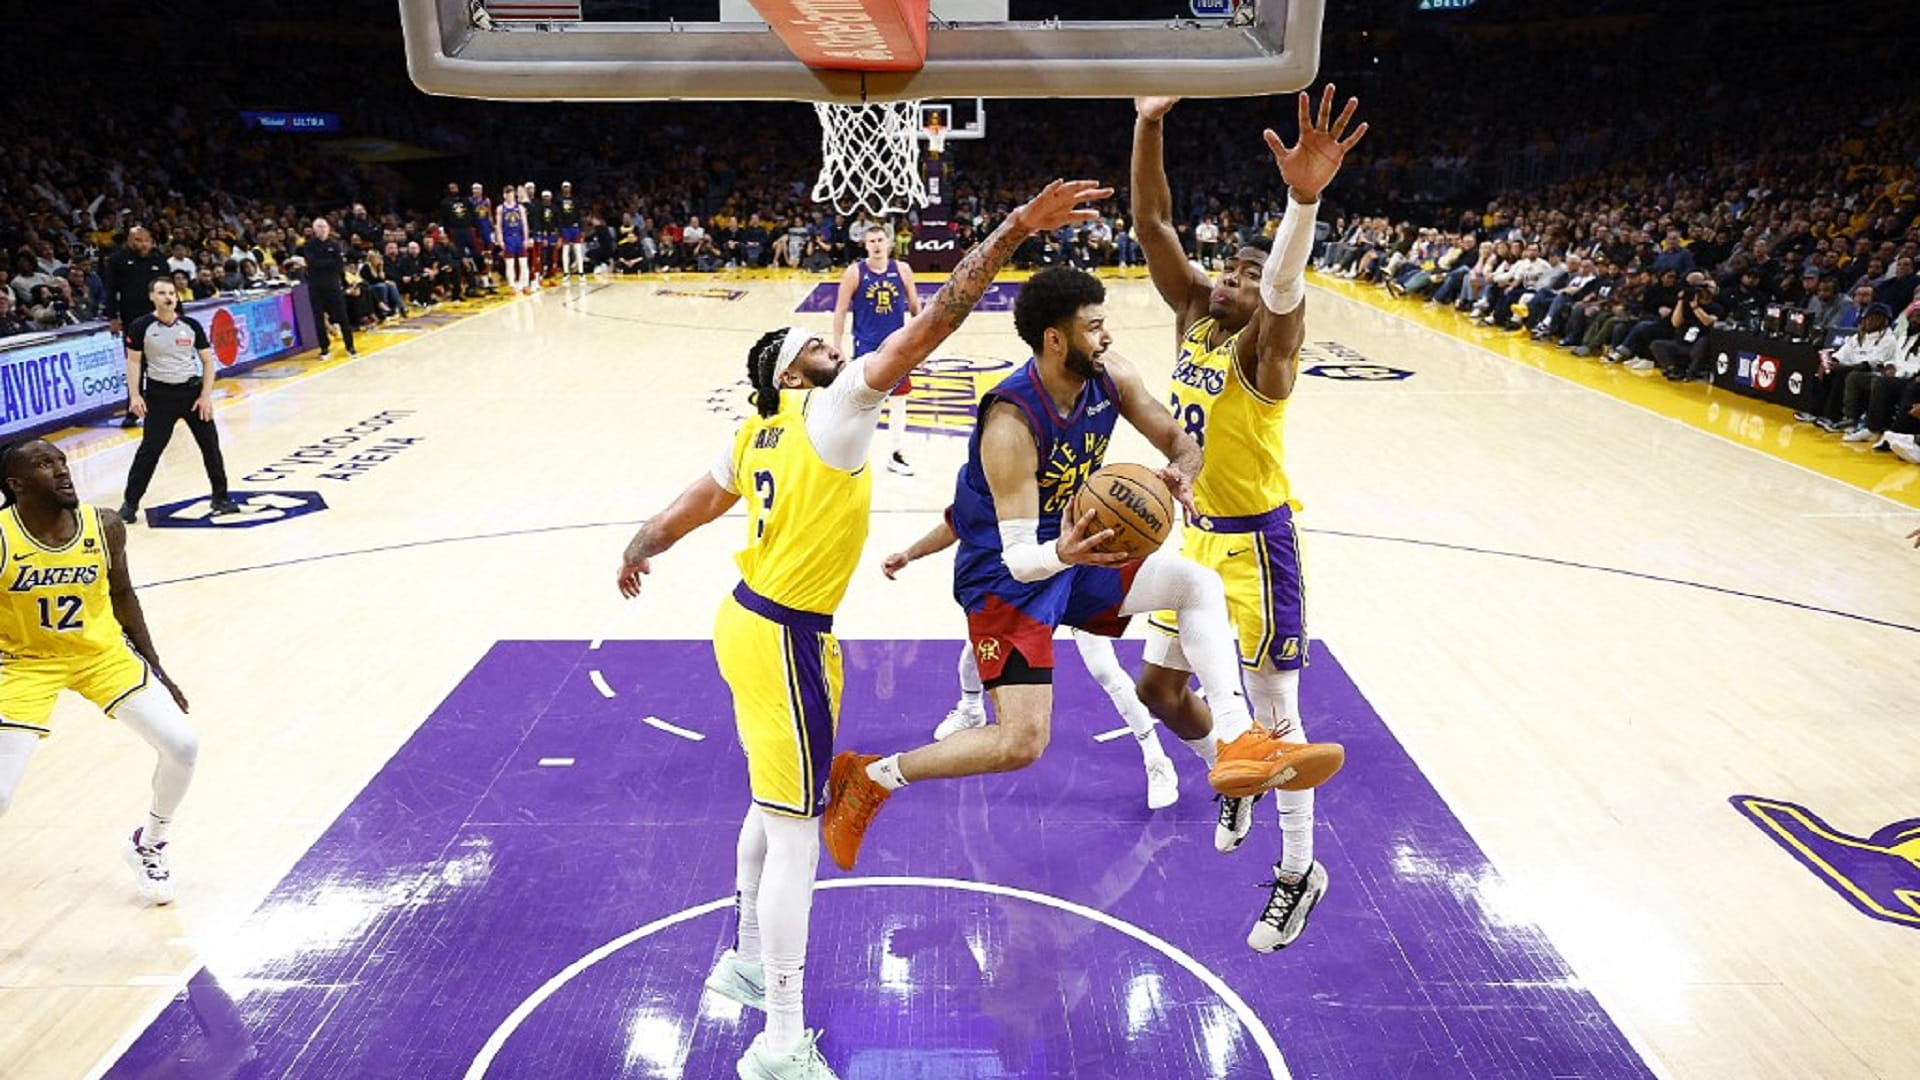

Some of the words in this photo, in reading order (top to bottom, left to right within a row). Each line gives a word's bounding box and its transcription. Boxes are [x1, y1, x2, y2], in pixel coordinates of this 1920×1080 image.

[877, 291, 890, 306] 15
[0, 352, 76, 426] AYOFFS
[315, 437, 426, 482] ARENA
[1108, 480, 1163, 534] Wilson
[8, 564, 99, 592] LAKERS
[37, 595, 84, 630] 12
